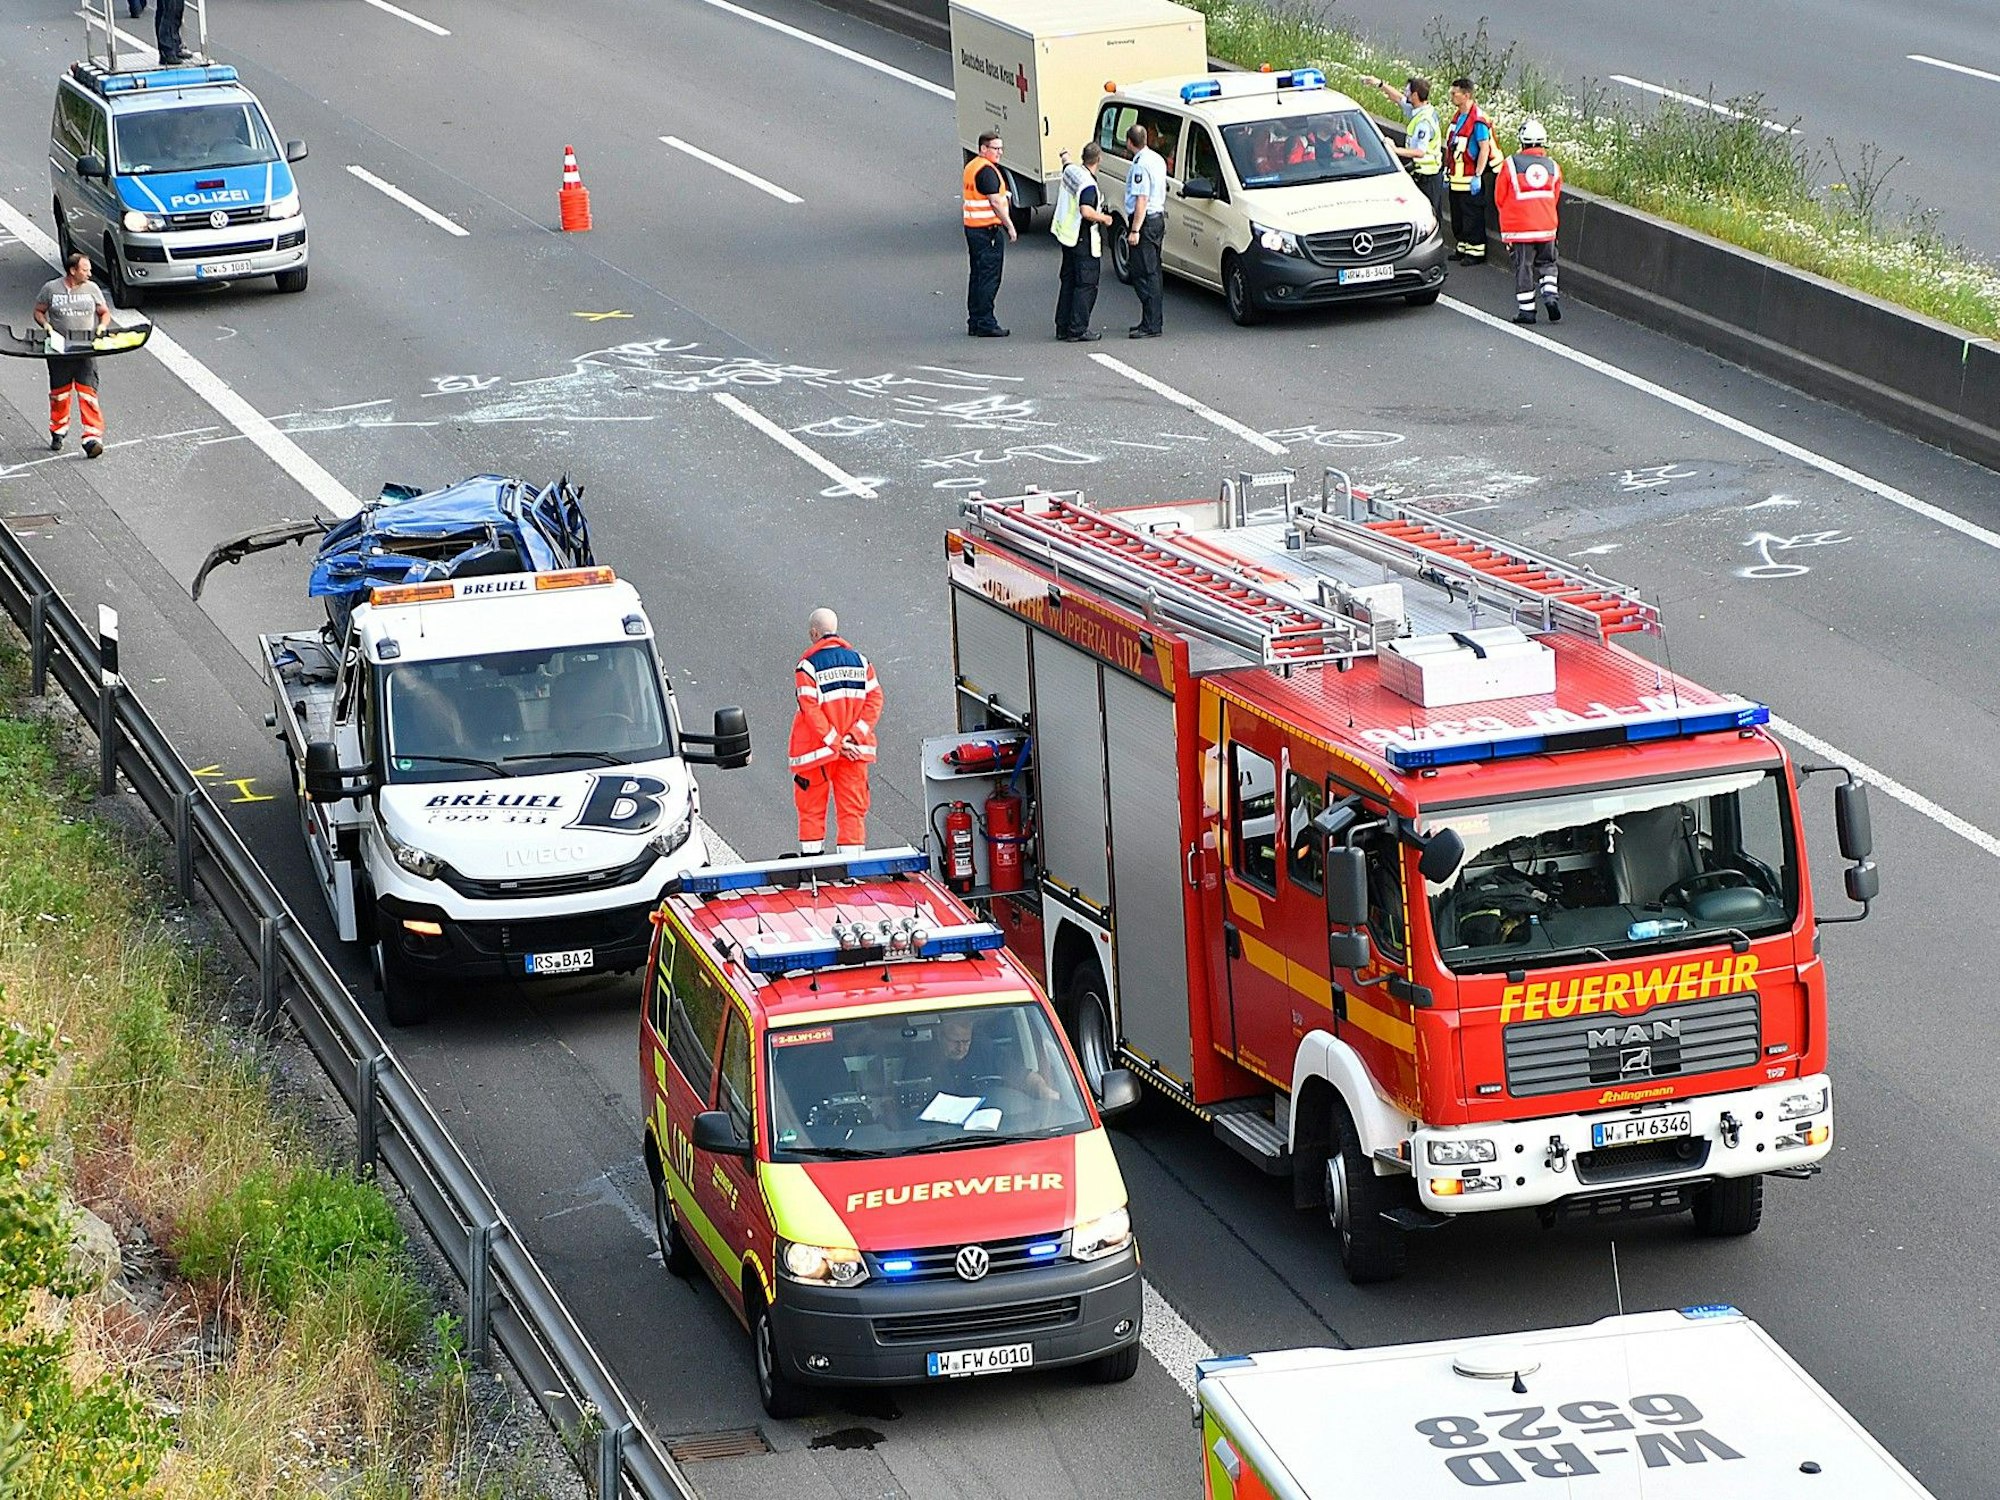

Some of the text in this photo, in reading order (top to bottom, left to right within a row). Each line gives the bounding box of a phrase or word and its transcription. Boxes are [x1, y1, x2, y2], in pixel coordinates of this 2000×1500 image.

[170, 188, 251, 208] POLIZEI
[462, 580, 528, 596] BREUEL
[1047, 603, 1114, 661] WUPPERTAL
[1122, 637, 1142, 676] 112
[818, 668, 866, 682] FEUERWEHR
[561, 772, 671, 836] B
[505, 844, 587, 868] IVECO
[534, 951, 593, 970] RS BA 2
[1499, 953, 1761, 1024] FEUERWEHR
[1586, 1017, 1682, 1050] MAN
[1598, 1086, 1675, 1105] Schlingmann
[1604, 1126, 1615, 1142] W
[1625, 1121, 1646, 1139] FW
[1649, 1115, 1690, 1136] 6346
[677, 1127, 696, 1194] 112
[846, 1172, 1065, 1214] FEUERWEHR
[939, 1346, 1030, 1371] W FW 6010
[1414, 1393, 1704, 1450] 6528
[1444, 1428, 1746, 1487] W-RD
